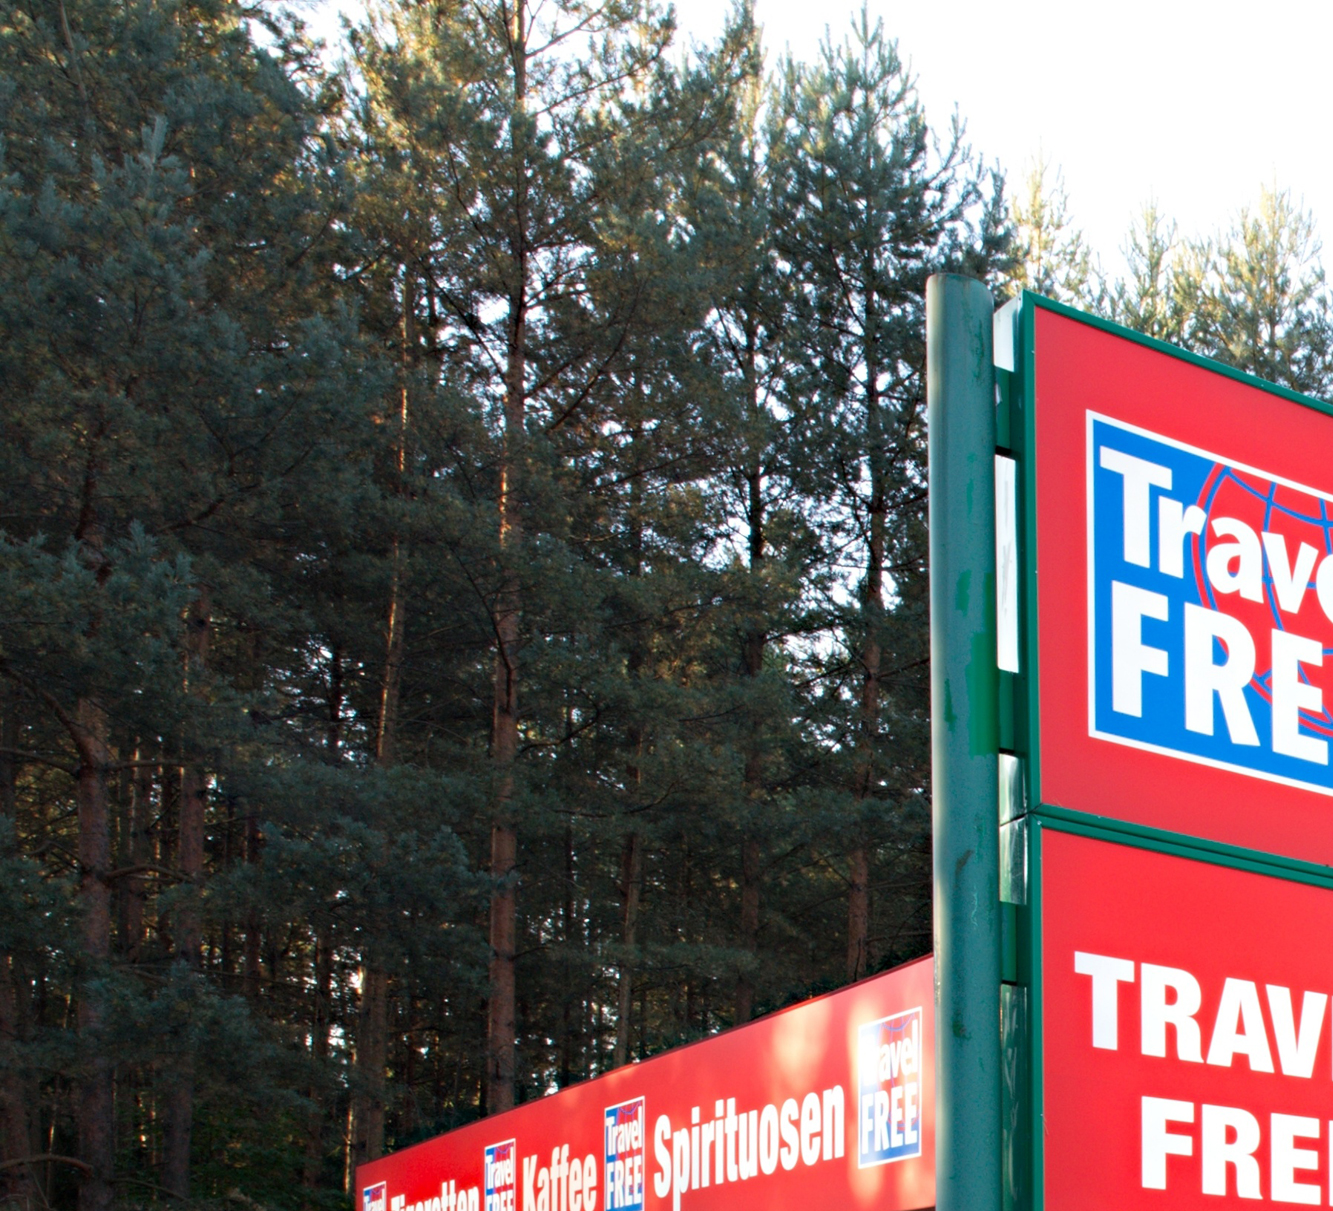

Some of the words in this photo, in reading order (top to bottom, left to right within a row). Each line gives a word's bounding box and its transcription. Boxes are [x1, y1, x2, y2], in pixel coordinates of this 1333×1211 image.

[605, 1105, 642, 1157] Travel
[861, 1082, 918, 1155] FREE
[485, 1146, 514, 1190] Travel
[606, 1155, 642, 1210] FREE
